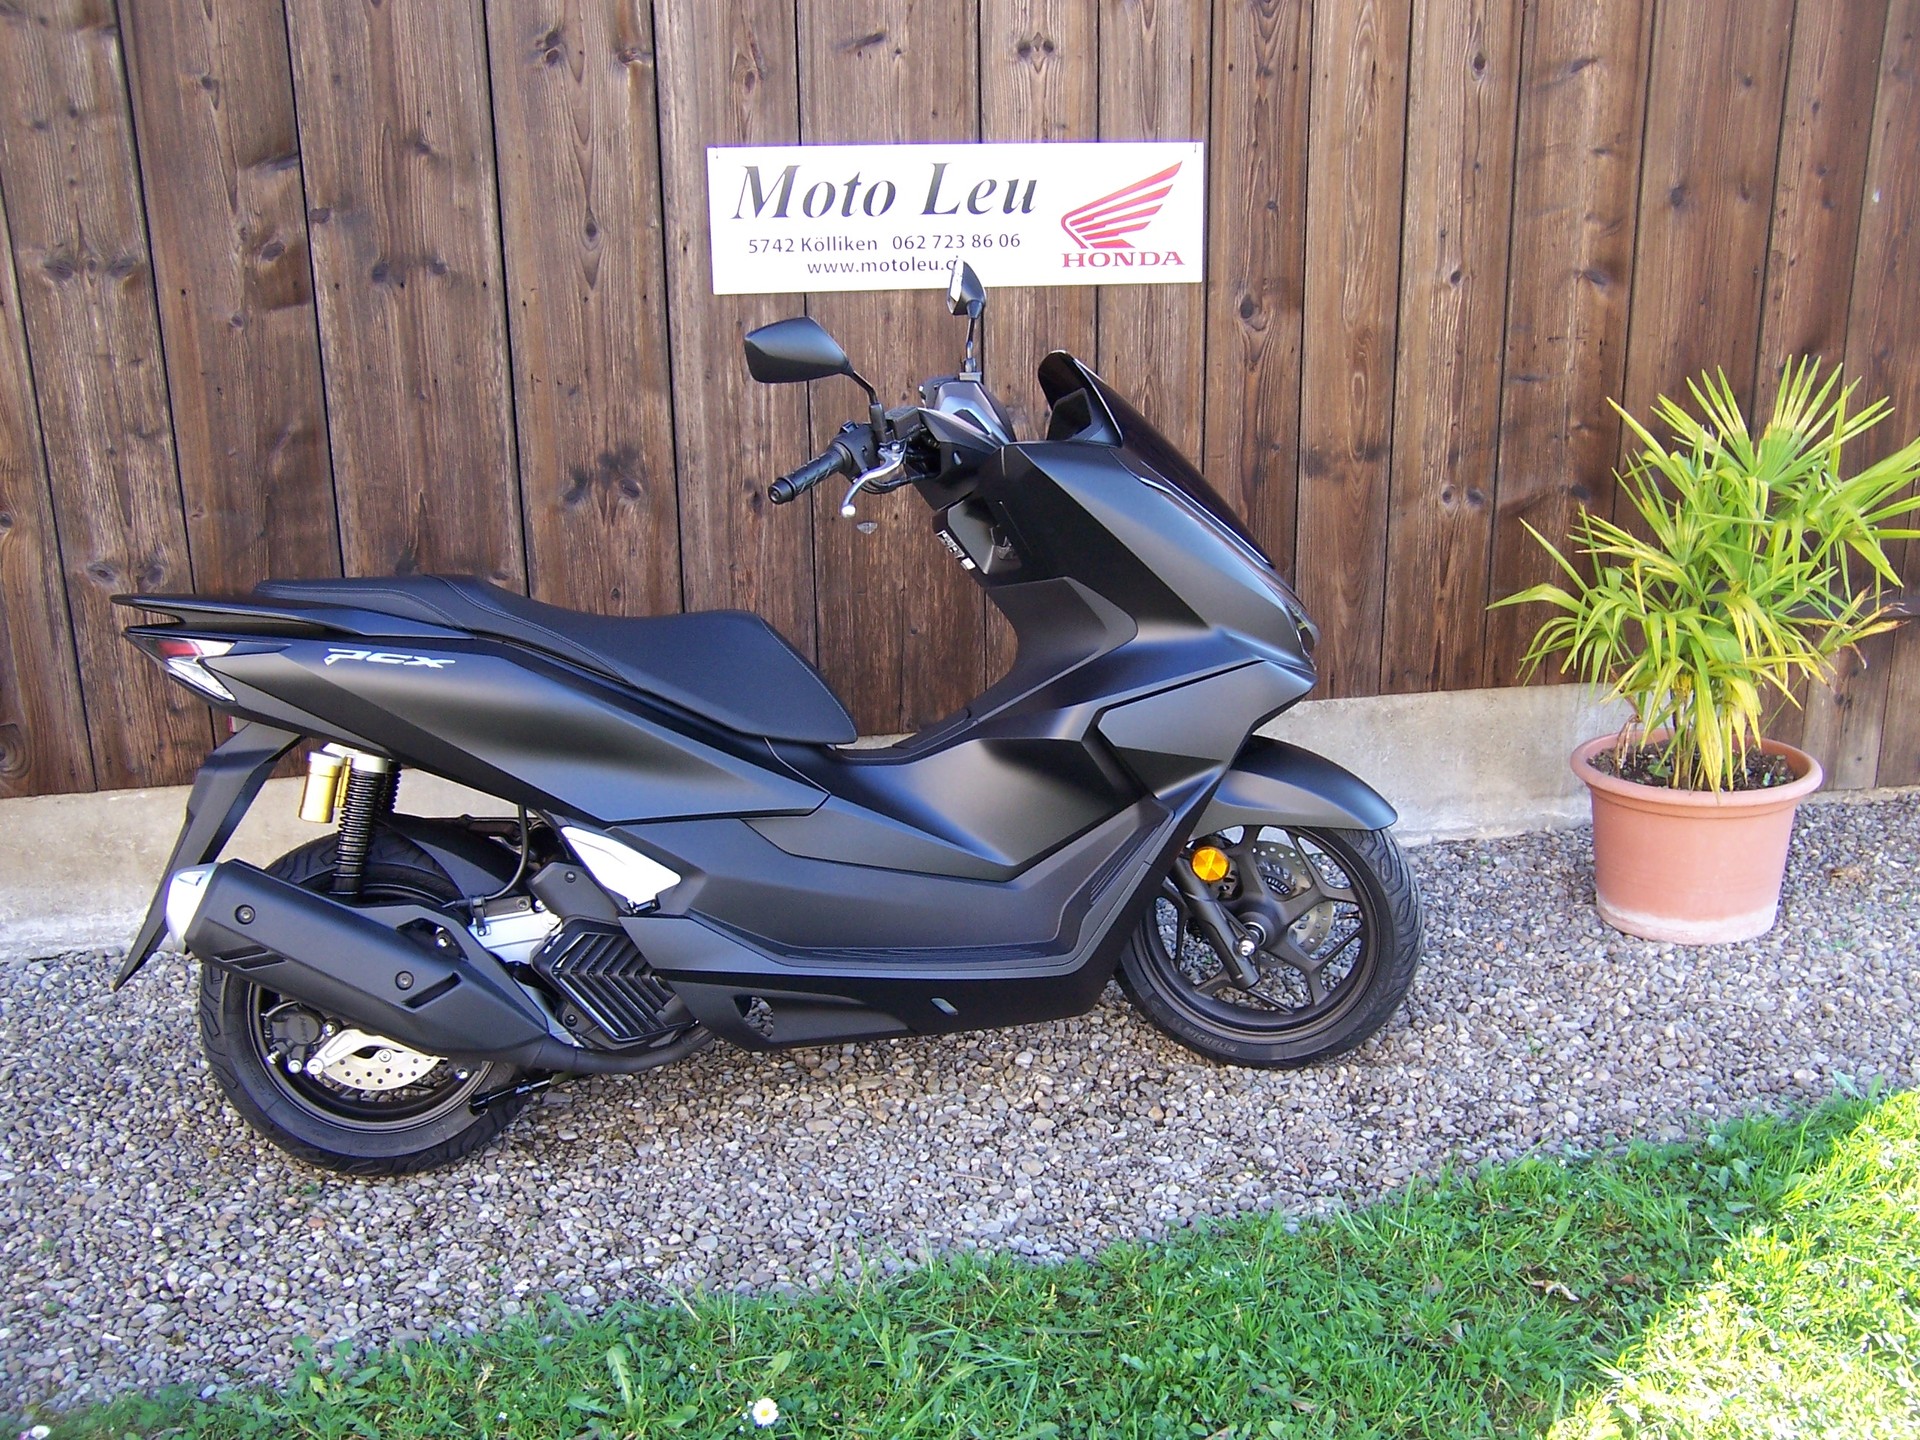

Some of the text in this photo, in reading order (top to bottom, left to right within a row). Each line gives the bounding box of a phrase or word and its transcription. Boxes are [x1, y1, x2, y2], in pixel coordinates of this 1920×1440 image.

[732, 162, 1038, 220] Moto Leu
[749, 233, 1021, 254] 5742 Kölliken 062 723 86 06
[807, 256, 959, 274] www.motoleu.c
[1062, 251, 1185, 269] HONDA
[323, 648, 456, 669] PCX
